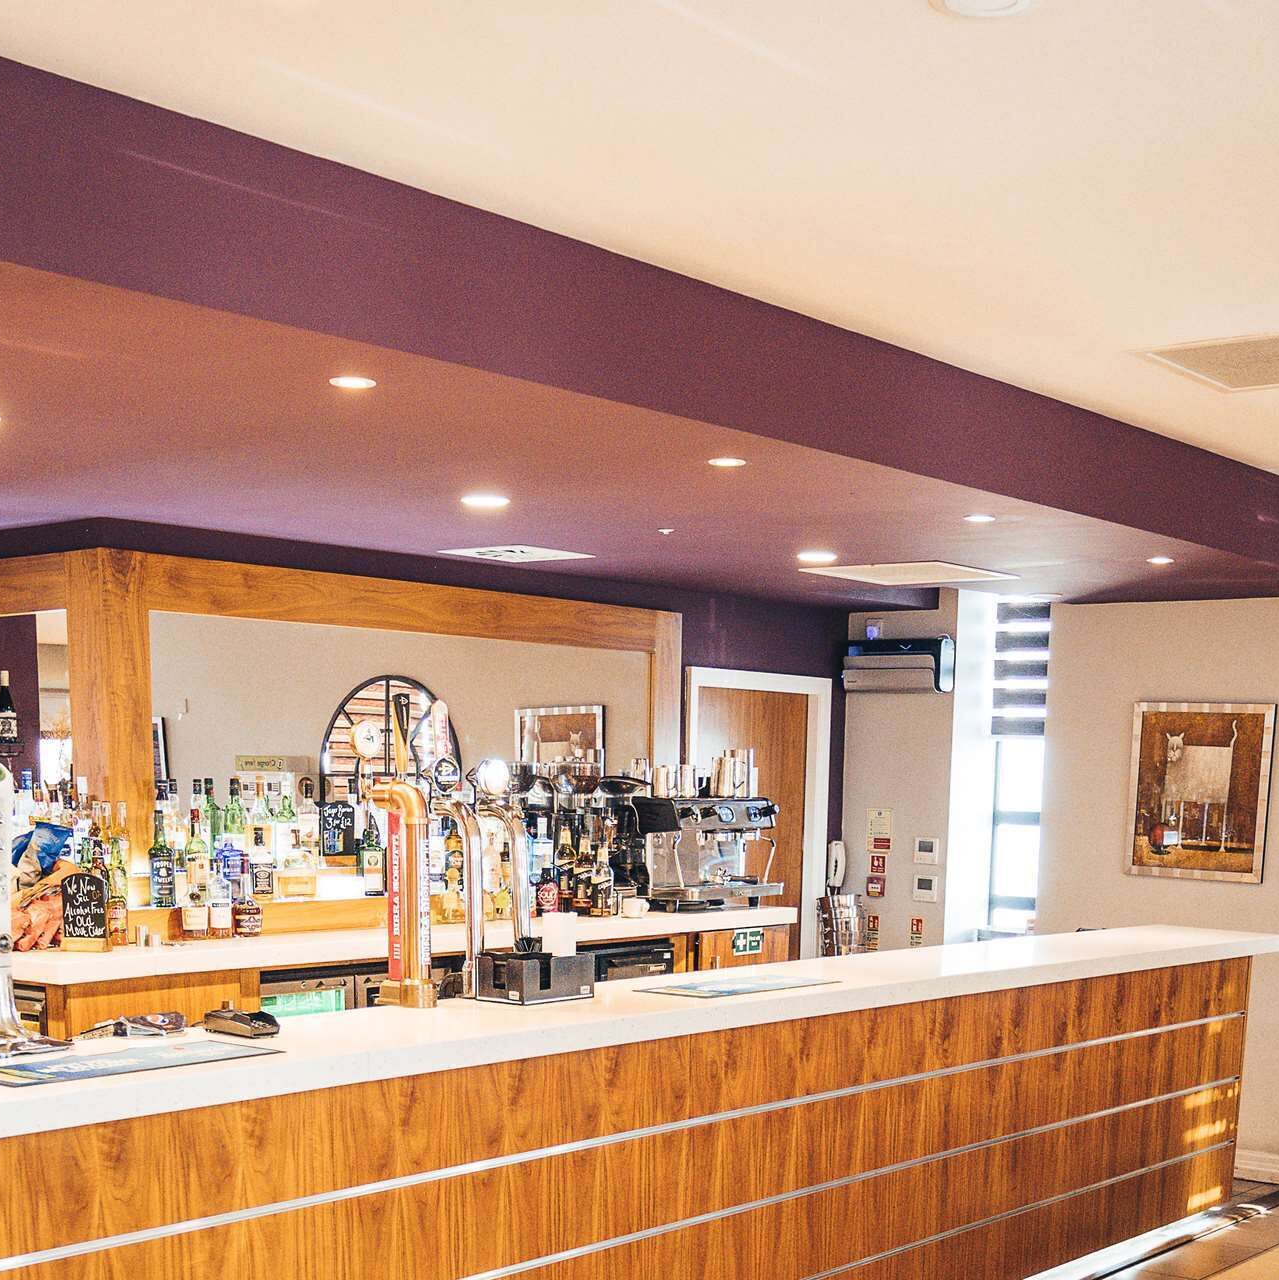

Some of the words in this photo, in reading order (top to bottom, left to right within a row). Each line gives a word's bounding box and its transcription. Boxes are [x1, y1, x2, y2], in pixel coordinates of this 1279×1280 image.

[326, 818, 332, 829] 3
[340, 817, 353, 829] £12
[91, 902, 104, 914] Free
[76, 915, 94, 927] Old
